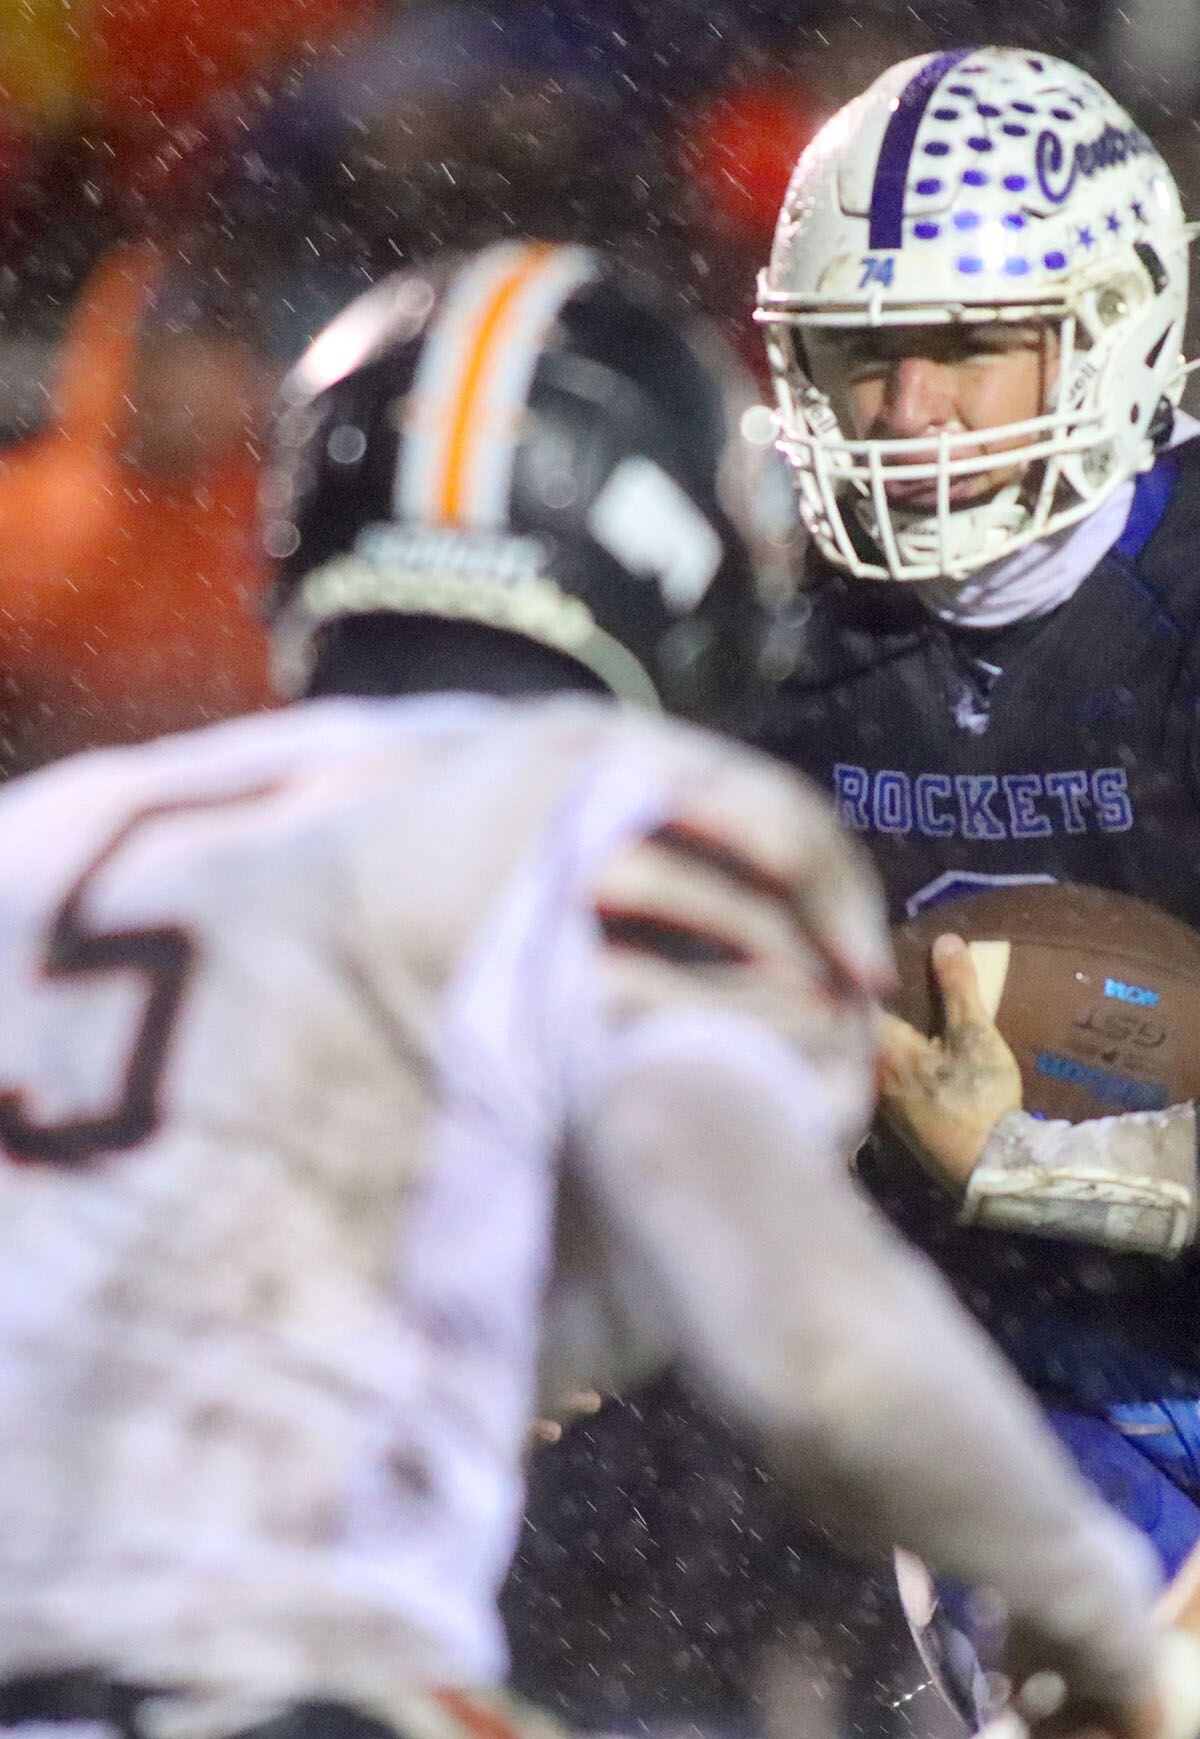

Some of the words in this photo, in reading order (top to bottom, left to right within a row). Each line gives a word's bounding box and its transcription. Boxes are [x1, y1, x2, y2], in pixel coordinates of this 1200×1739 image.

[859, 256, 895, 288] 74
[833, 763, 1134, 839] ROCKETS
[0, 770, 292, 1168] 5
